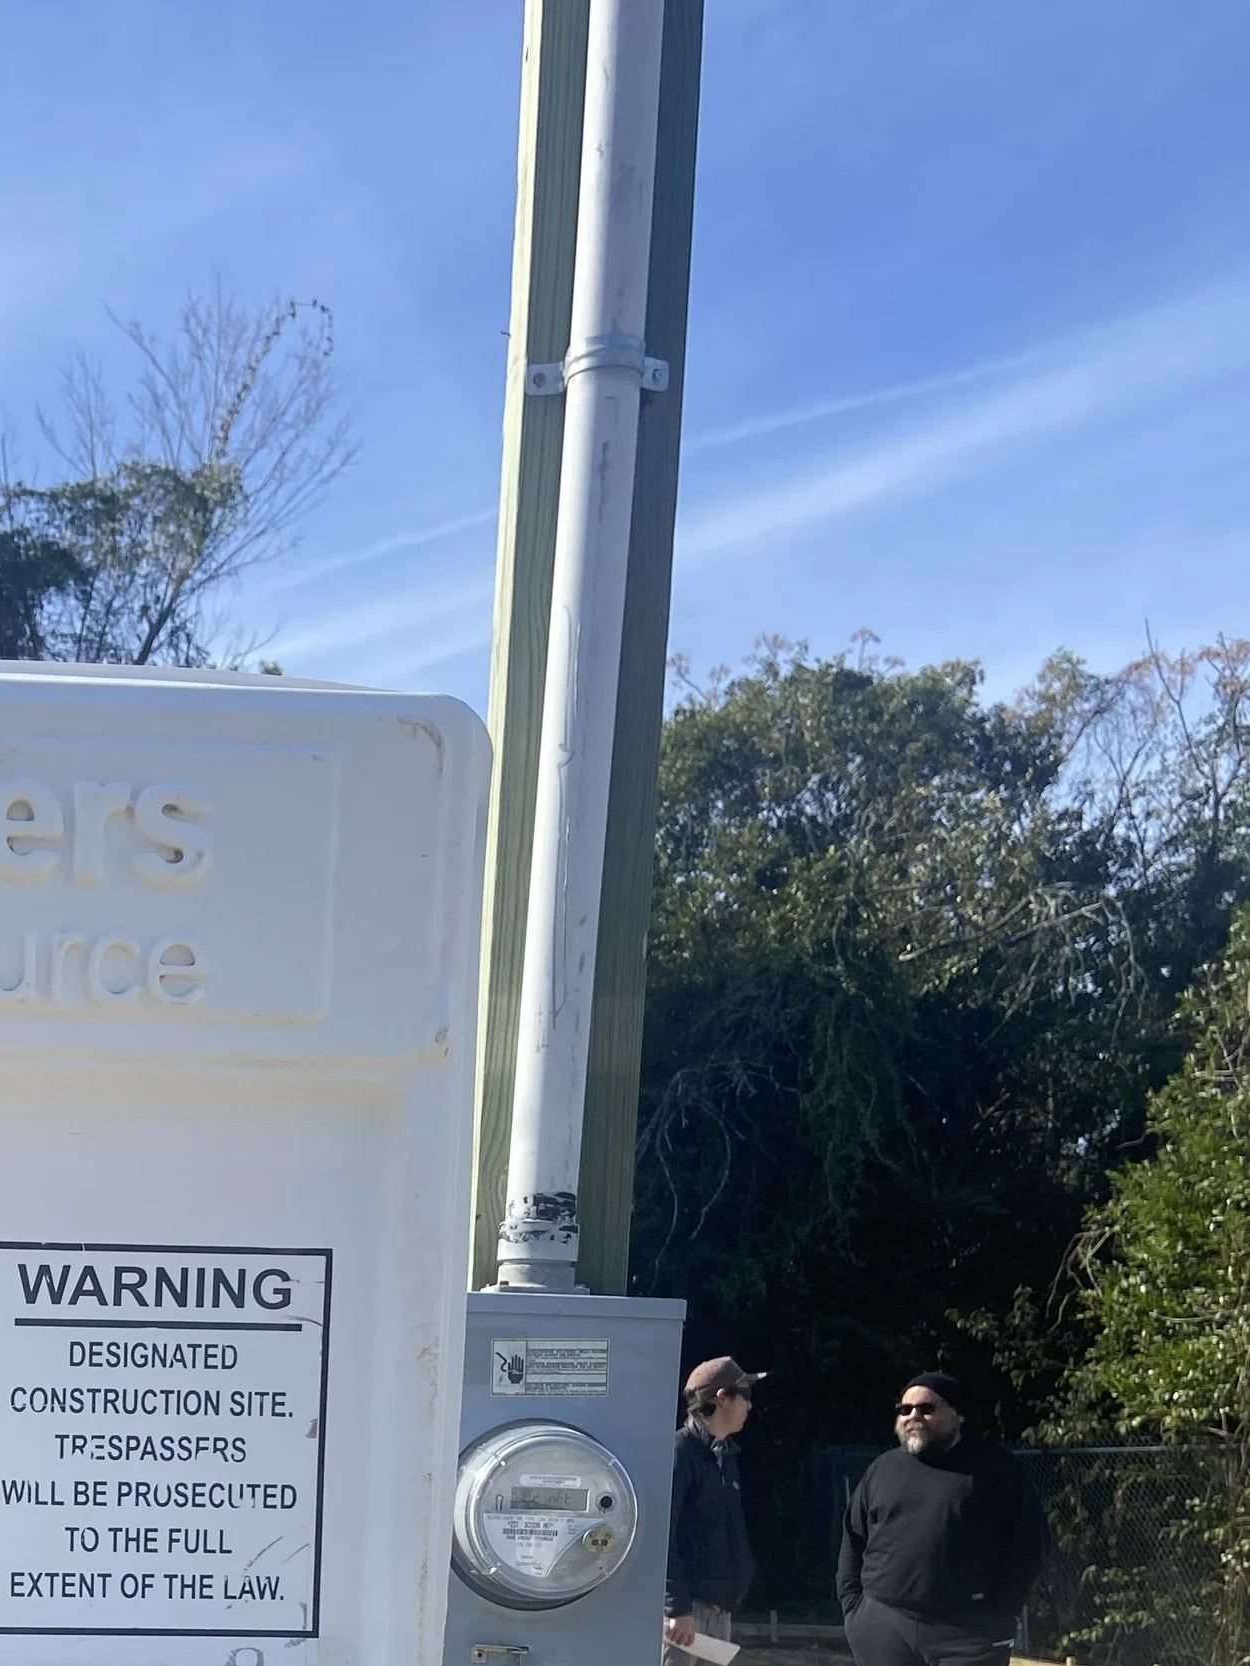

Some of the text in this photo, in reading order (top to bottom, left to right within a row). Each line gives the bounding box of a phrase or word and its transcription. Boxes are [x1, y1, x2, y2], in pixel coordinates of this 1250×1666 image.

[18, 1264, 291, 1309] WARNING
[70, 1342, 237, 1369] DESIGNATED
[11, 1387, 292, 1417] CONSTRUCTION SITE.
[2, 1480, 296, 1509] WILL BE PROSECUTED
[65, 1527, 232, 1553] TO THE FULL
[11, 1572, 283, 1600] EXTENT OF THE LAW.
